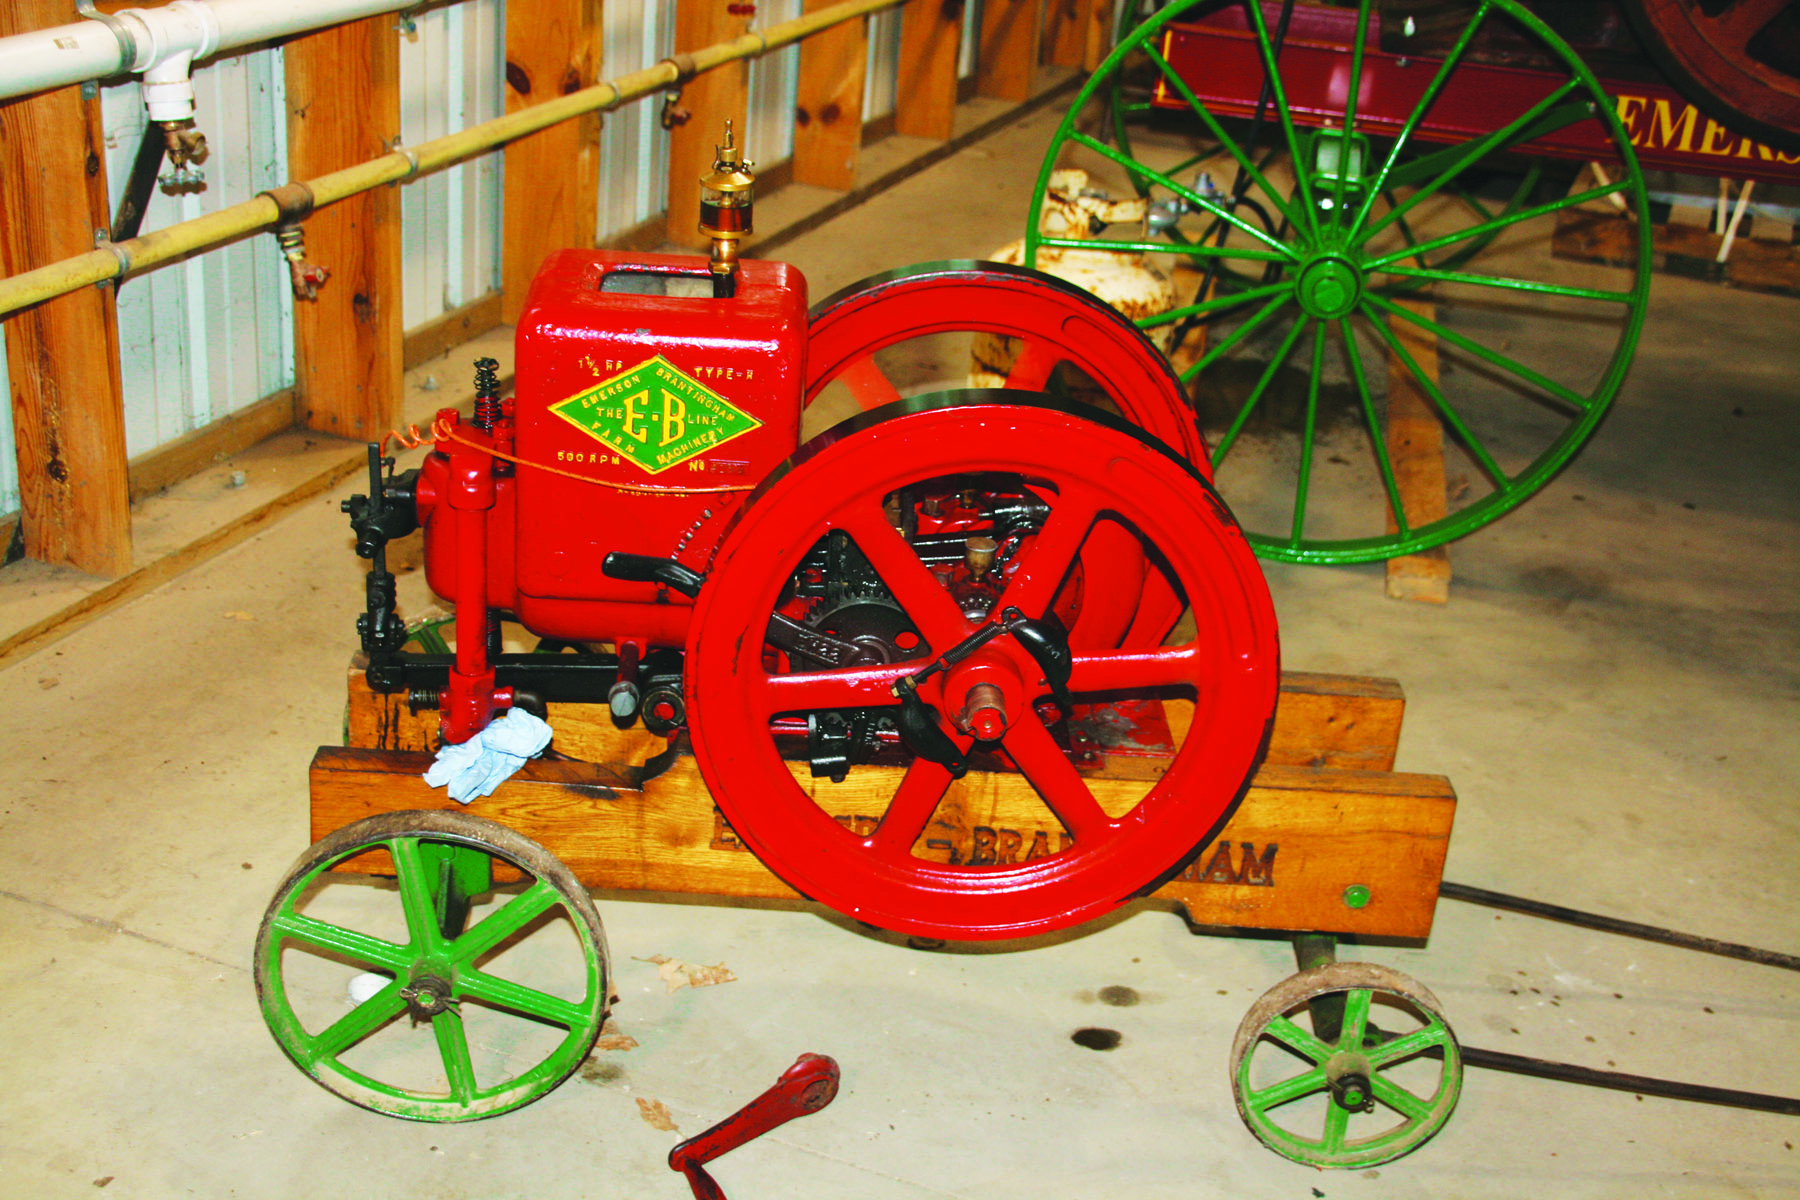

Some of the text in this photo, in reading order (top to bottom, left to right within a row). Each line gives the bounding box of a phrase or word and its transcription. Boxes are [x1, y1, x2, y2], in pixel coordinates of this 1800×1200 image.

[1604, 94, 1800, 164] EME
[605, 360, 624, 371] HP
[581, 375, 640, 408] EMERSON
[656, 367, 735, 422] BRANTINGHAM
[596, 407, 623, 420] THE
[688, 413, 718, 426] LINE
[591, 421, 636, 454] FARM
[656, 427, 724, 465] MACHINERY
[557, 451, 620, 465] 500 RPM
